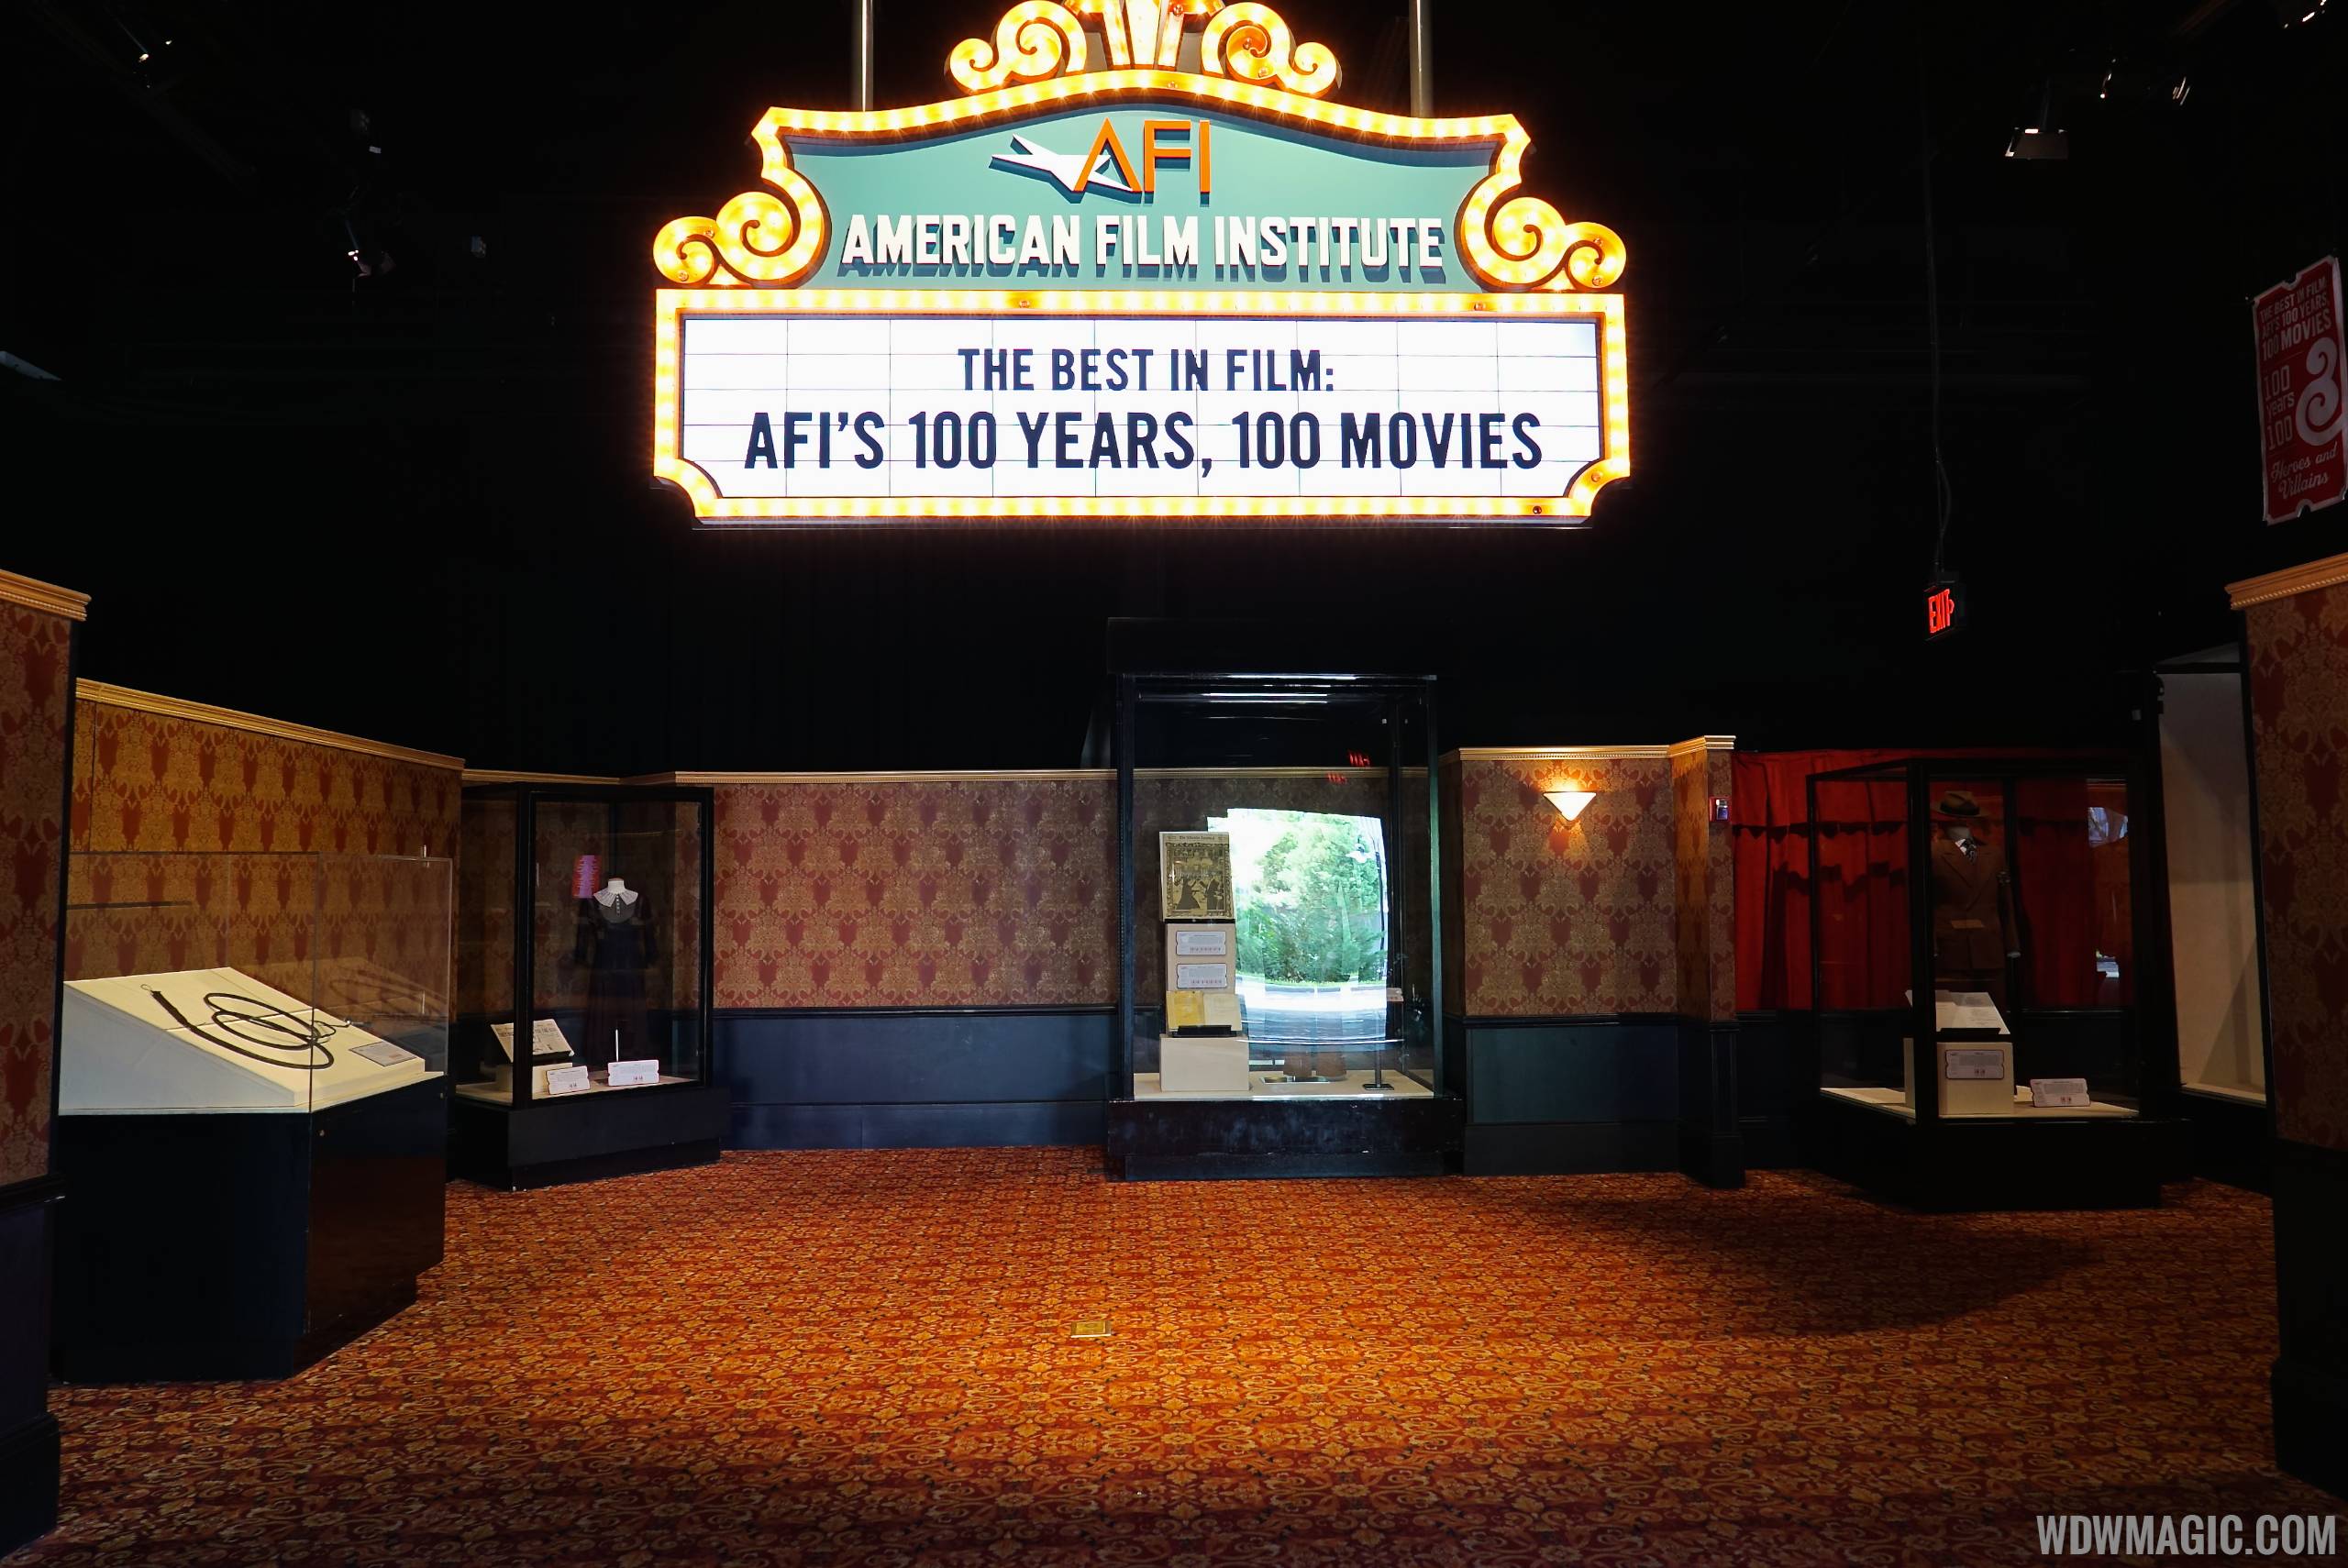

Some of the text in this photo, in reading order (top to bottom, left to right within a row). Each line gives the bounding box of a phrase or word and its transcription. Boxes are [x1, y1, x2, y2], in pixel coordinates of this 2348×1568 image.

[1073, 117, 1211, 193] AFI
[841, 214, 1444, 268] AMERICAN FILM INSTITUTE
[2275, 293, 2296, 315] BEST
[2282, 307, 2299, 327] 100
[2280, 308, 2332, 351] MOVIES
[958, 348, 1335, 392] THE BEST IN FILM:
[744, 410, 1543, 479] AFI’S 100 YEARS, 100 MOVIES
[2278, 470, 2330, 501] Villains
[1929, 589, 1951, 633] EXIT
